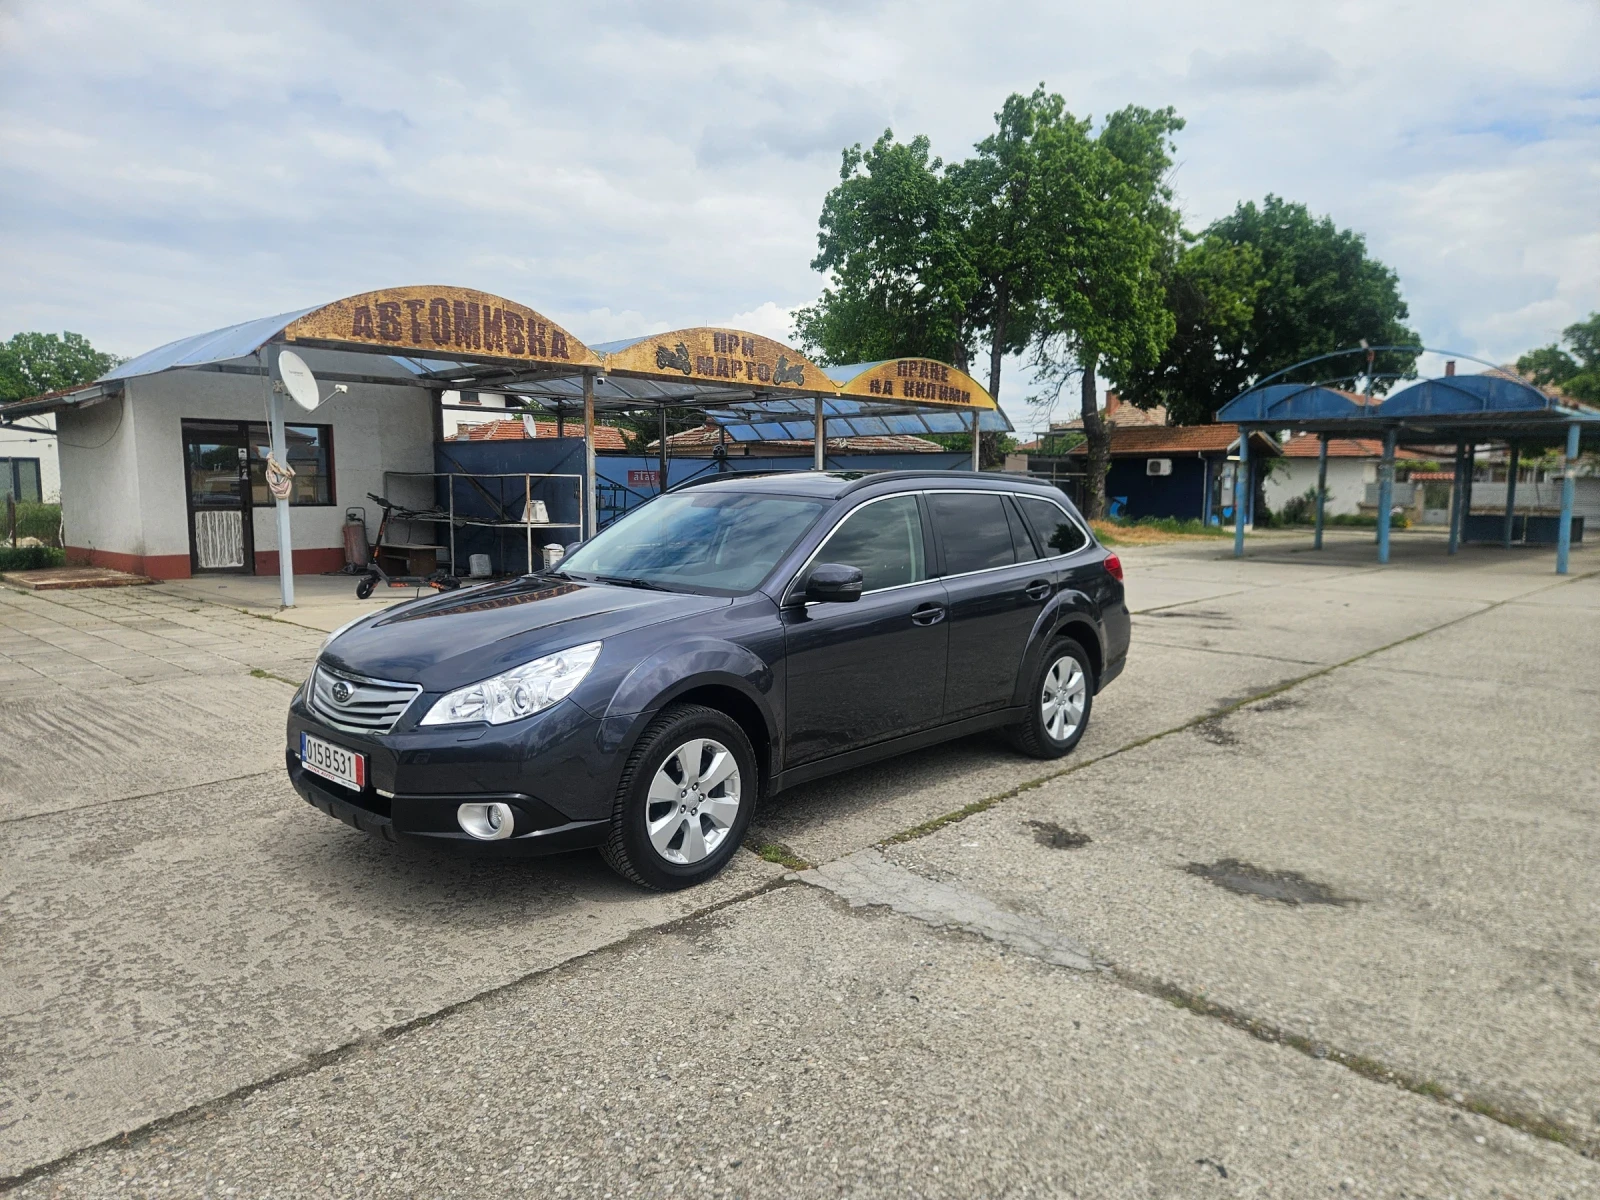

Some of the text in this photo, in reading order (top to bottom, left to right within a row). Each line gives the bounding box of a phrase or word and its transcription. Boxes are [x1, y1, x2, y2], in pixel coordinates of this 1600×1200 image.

[352, 297, 570, 360] АВТОМИВКА
[713, 332, 755, 357] ПРИ
[697, 356, 771, 382] МАРТО
[897, 360, 949, 383] ПРАНЕ
[870, 379, 971, 404] НА КИЛИМИ
